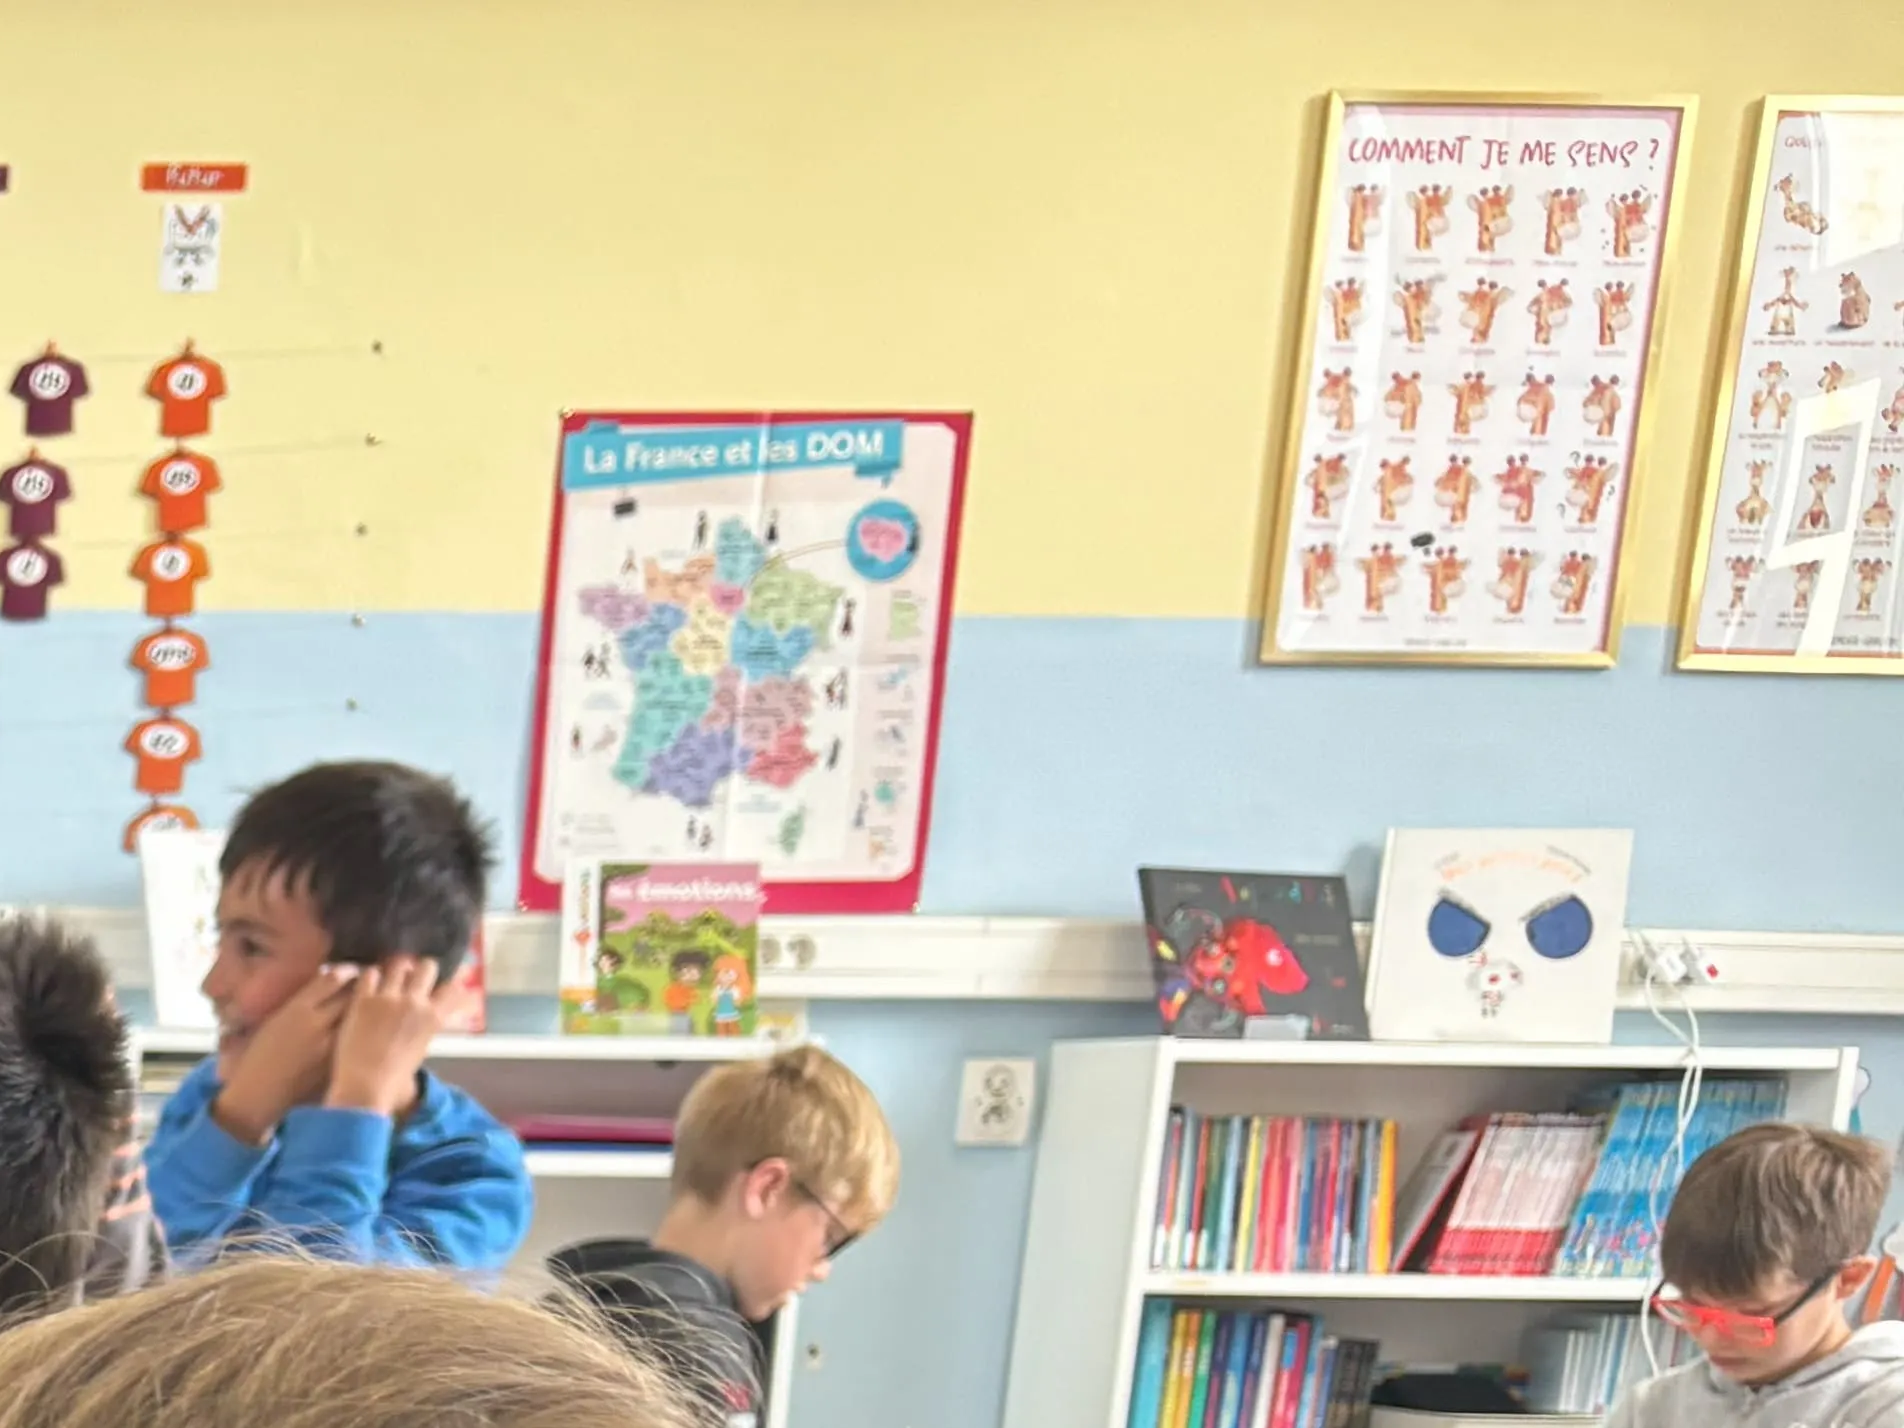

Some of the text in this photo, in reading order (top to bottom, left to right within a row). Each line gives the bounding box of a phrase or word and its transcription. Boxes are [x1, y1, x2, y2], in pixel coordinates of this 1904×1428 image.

[1348, 135, 1471, 165] COMMENT
[1480, 138, 1510, 169] JE
[1520, 139, 1558, 167] ME
[1568, 139, 1640, 169] SENS
[583, 429, 885, 475] La France et les DOM
